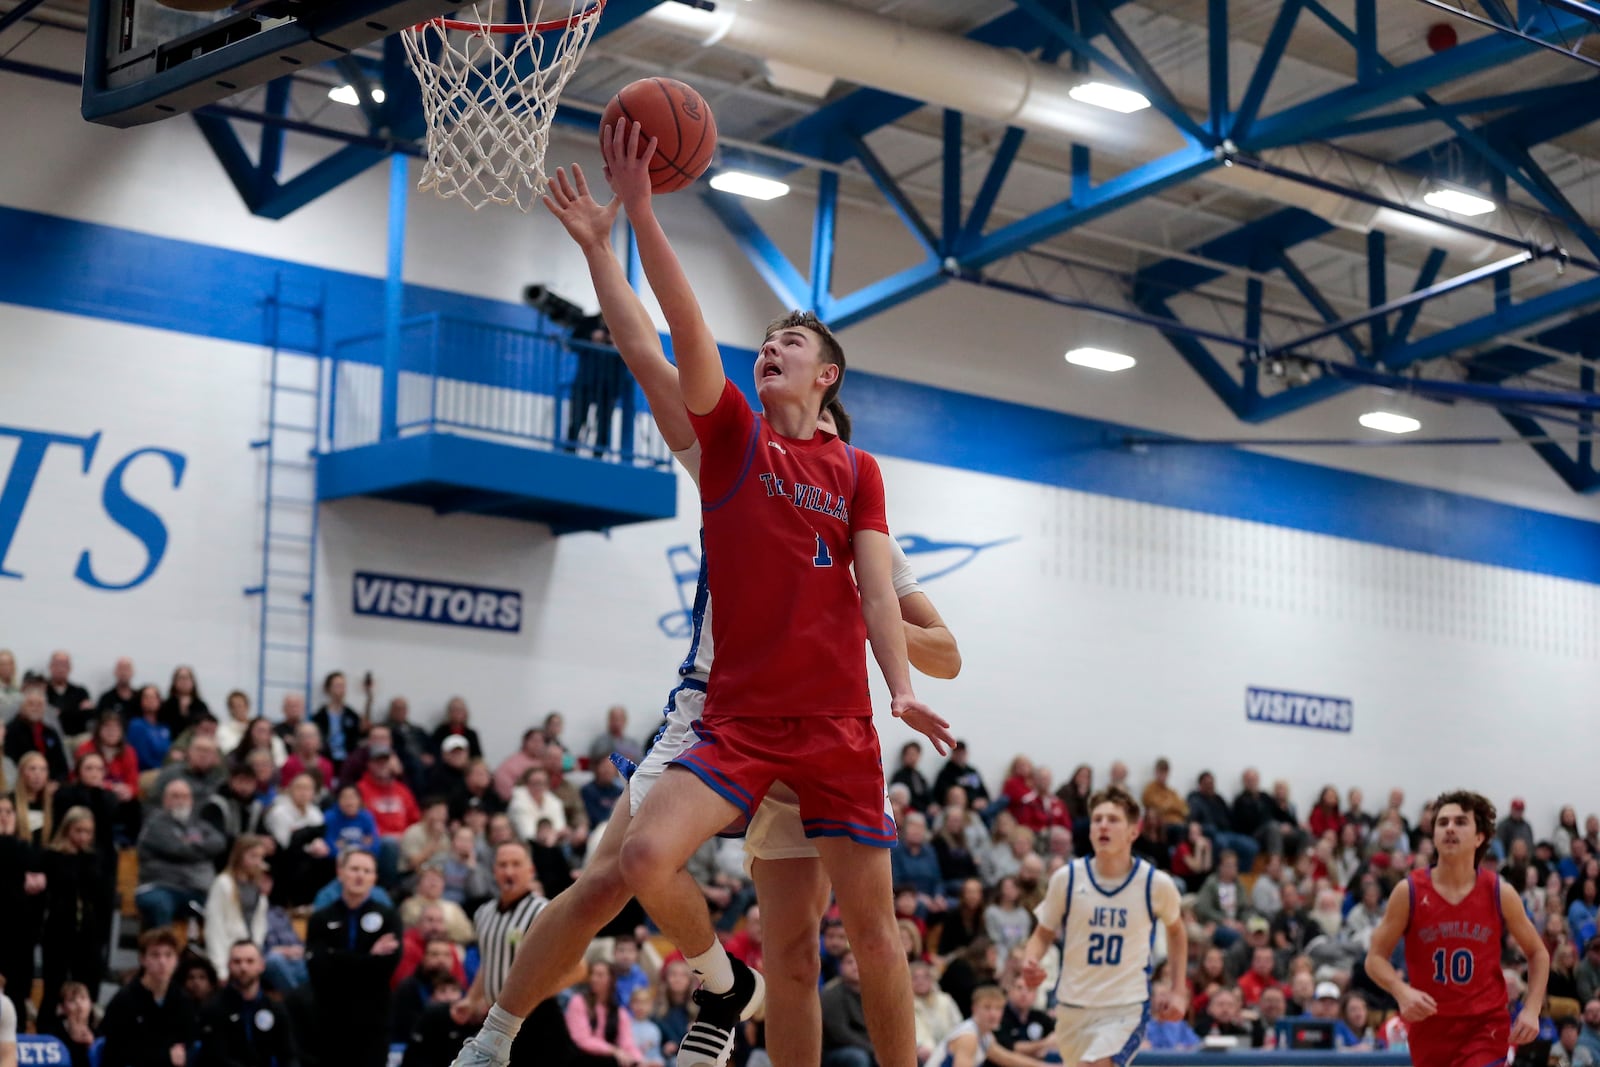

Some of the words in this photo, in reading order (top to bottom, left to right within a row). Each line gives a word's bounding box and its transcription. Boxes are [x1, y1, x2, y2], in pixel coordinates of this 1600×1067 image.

[813, 532, 832, 567] 1
[356, 577, 520, 628] VISITORS
[1248, 690, 1350, 728] VISITORS
[1089, 907, 1127, 928] JETS
[1088, 933, 1124, 965] 20
[1432, 947, 1474, 985] 10
[17, 1042, 61, 1064] ETS
